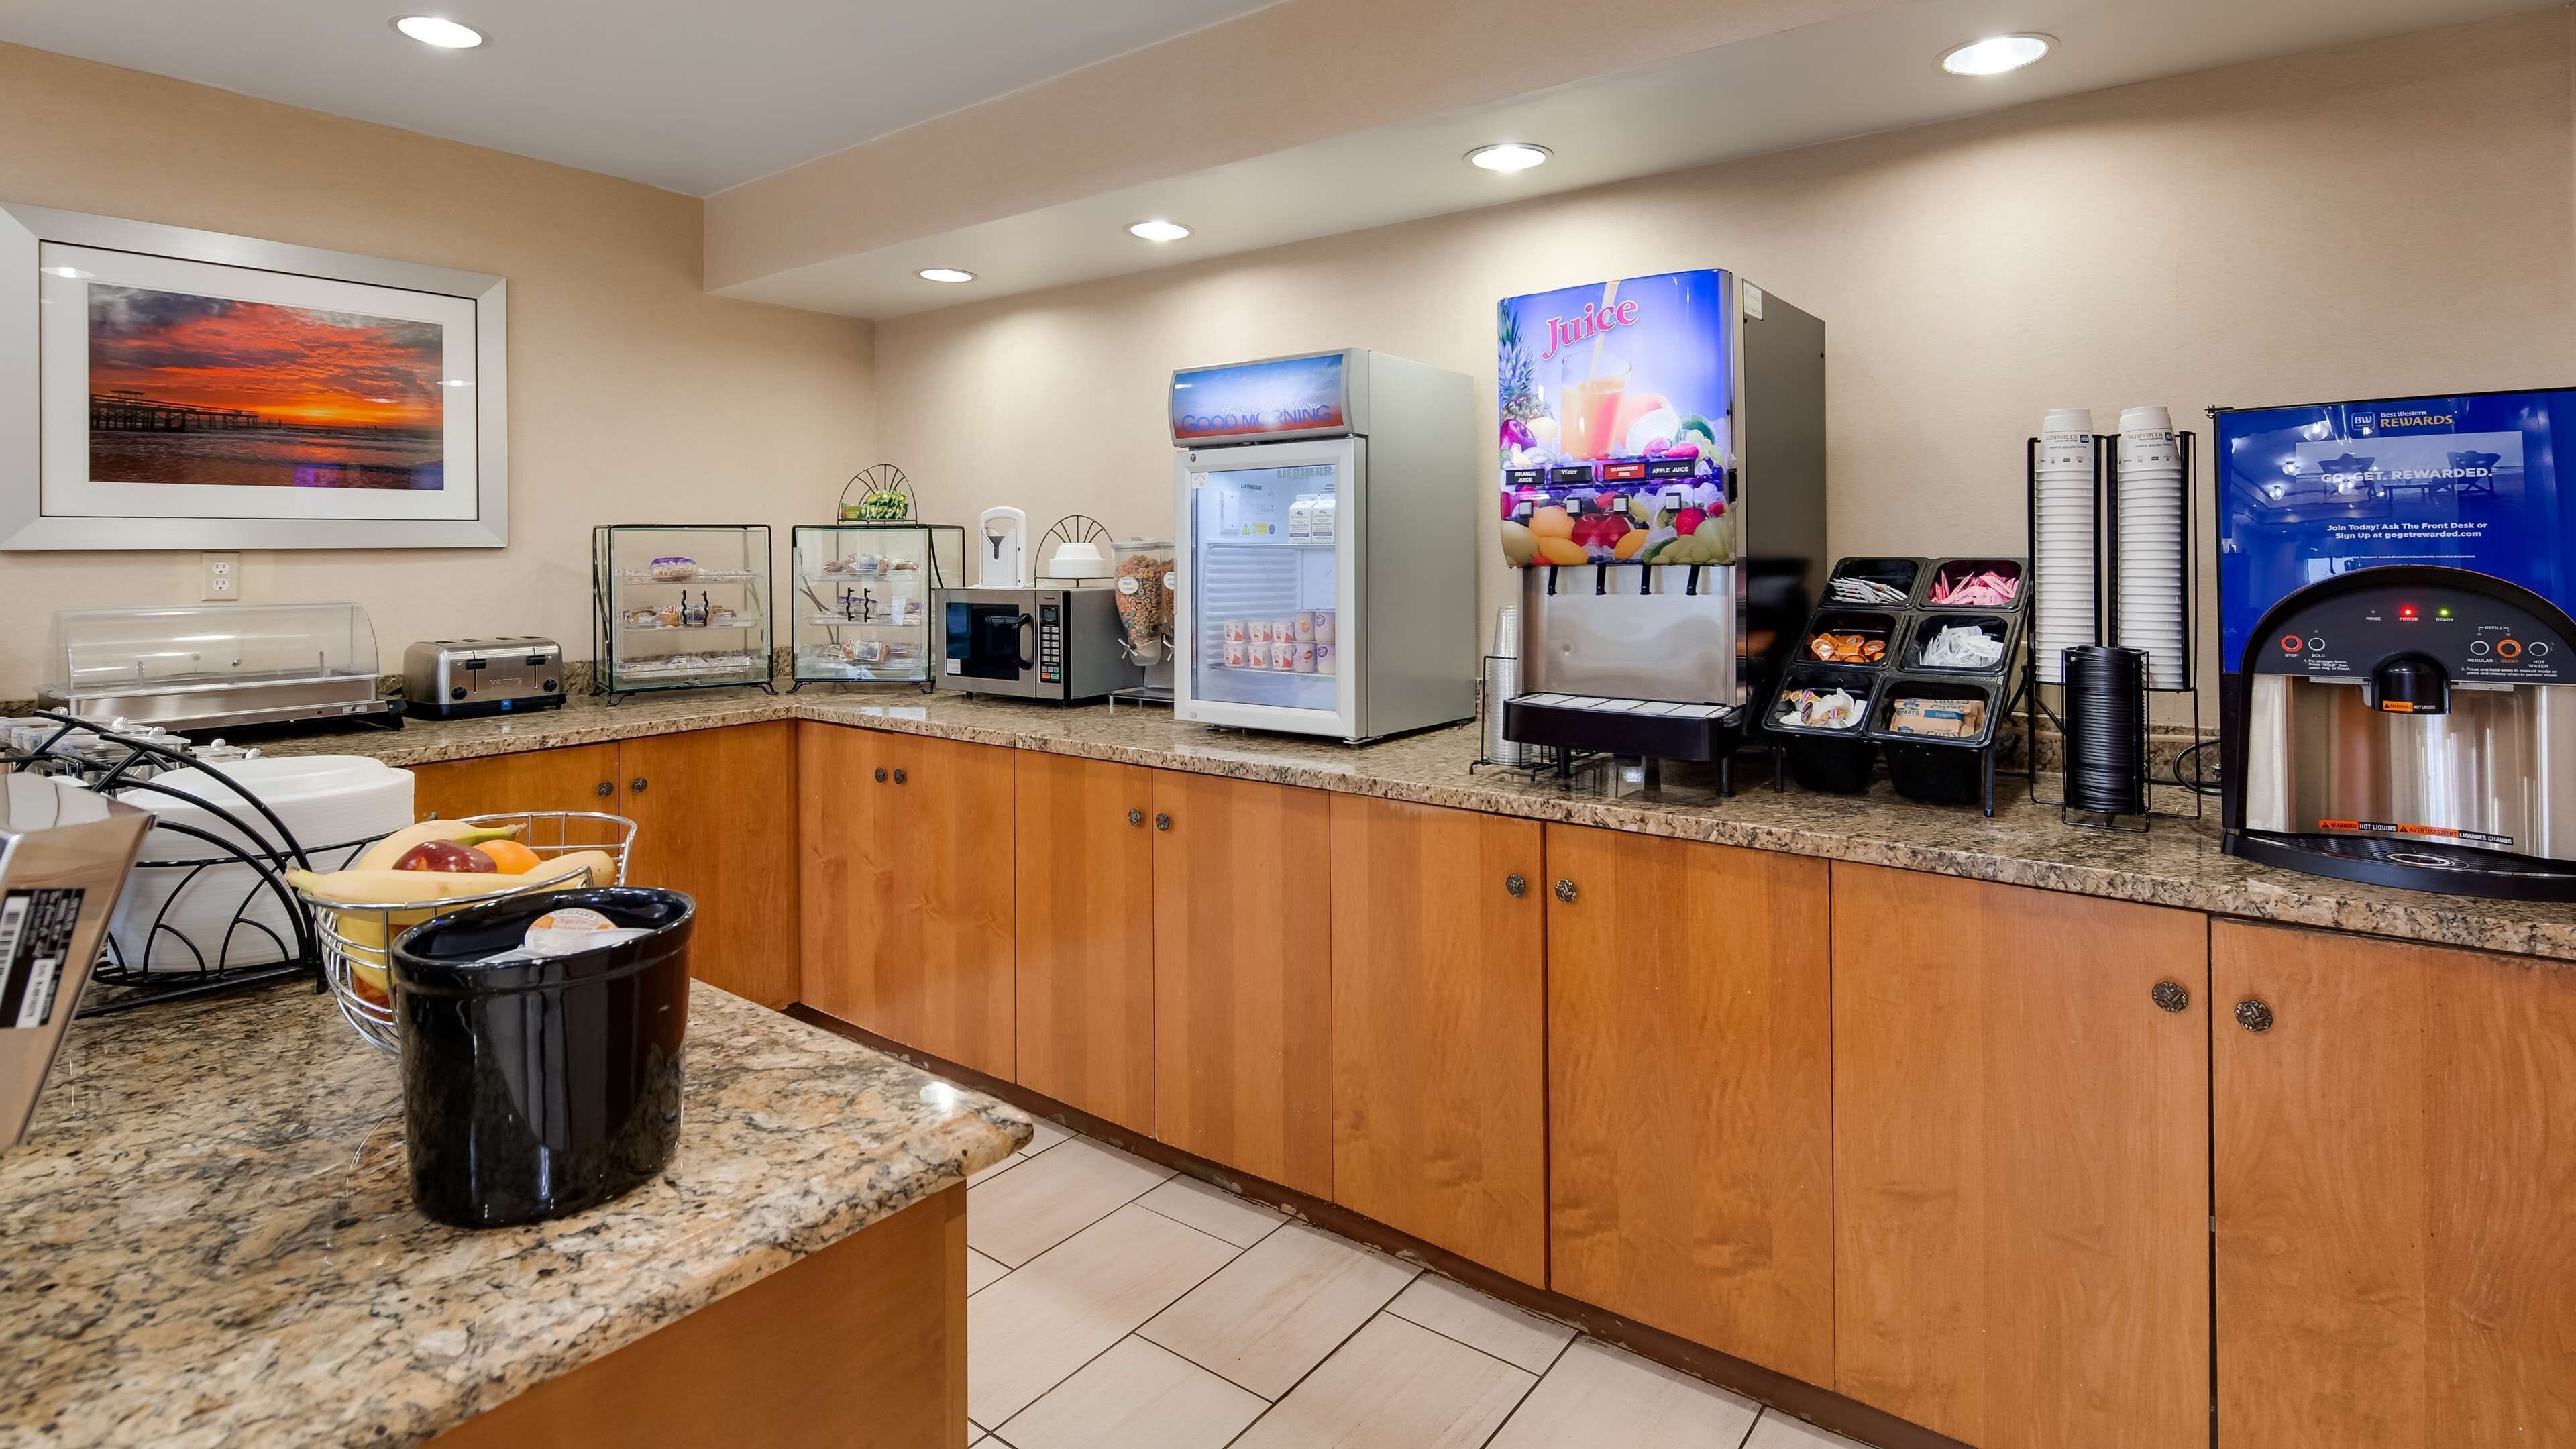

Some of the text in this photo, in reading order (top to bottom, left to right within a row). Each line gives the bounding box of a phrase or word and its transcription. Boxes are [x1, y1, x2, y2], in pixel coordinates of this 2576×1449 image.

[1542, 300, 1638, 360] Juice
[1182, 414, 1237, 433] GOOD
[2355, 416, 2372, 424] BW
[2392, 468, 2492, 480] REWARDED.
[2348, 524, 2379, 532] Today!
[2335, 532, 2355, 540] Sign
[2357, 532, 2371, 540] Up
[2385, 531, 2482, 539] gogetrewarded.com
[2409, 827, 2512, 844] AVERTISSEMENT LIQUIDES CHAUDS
